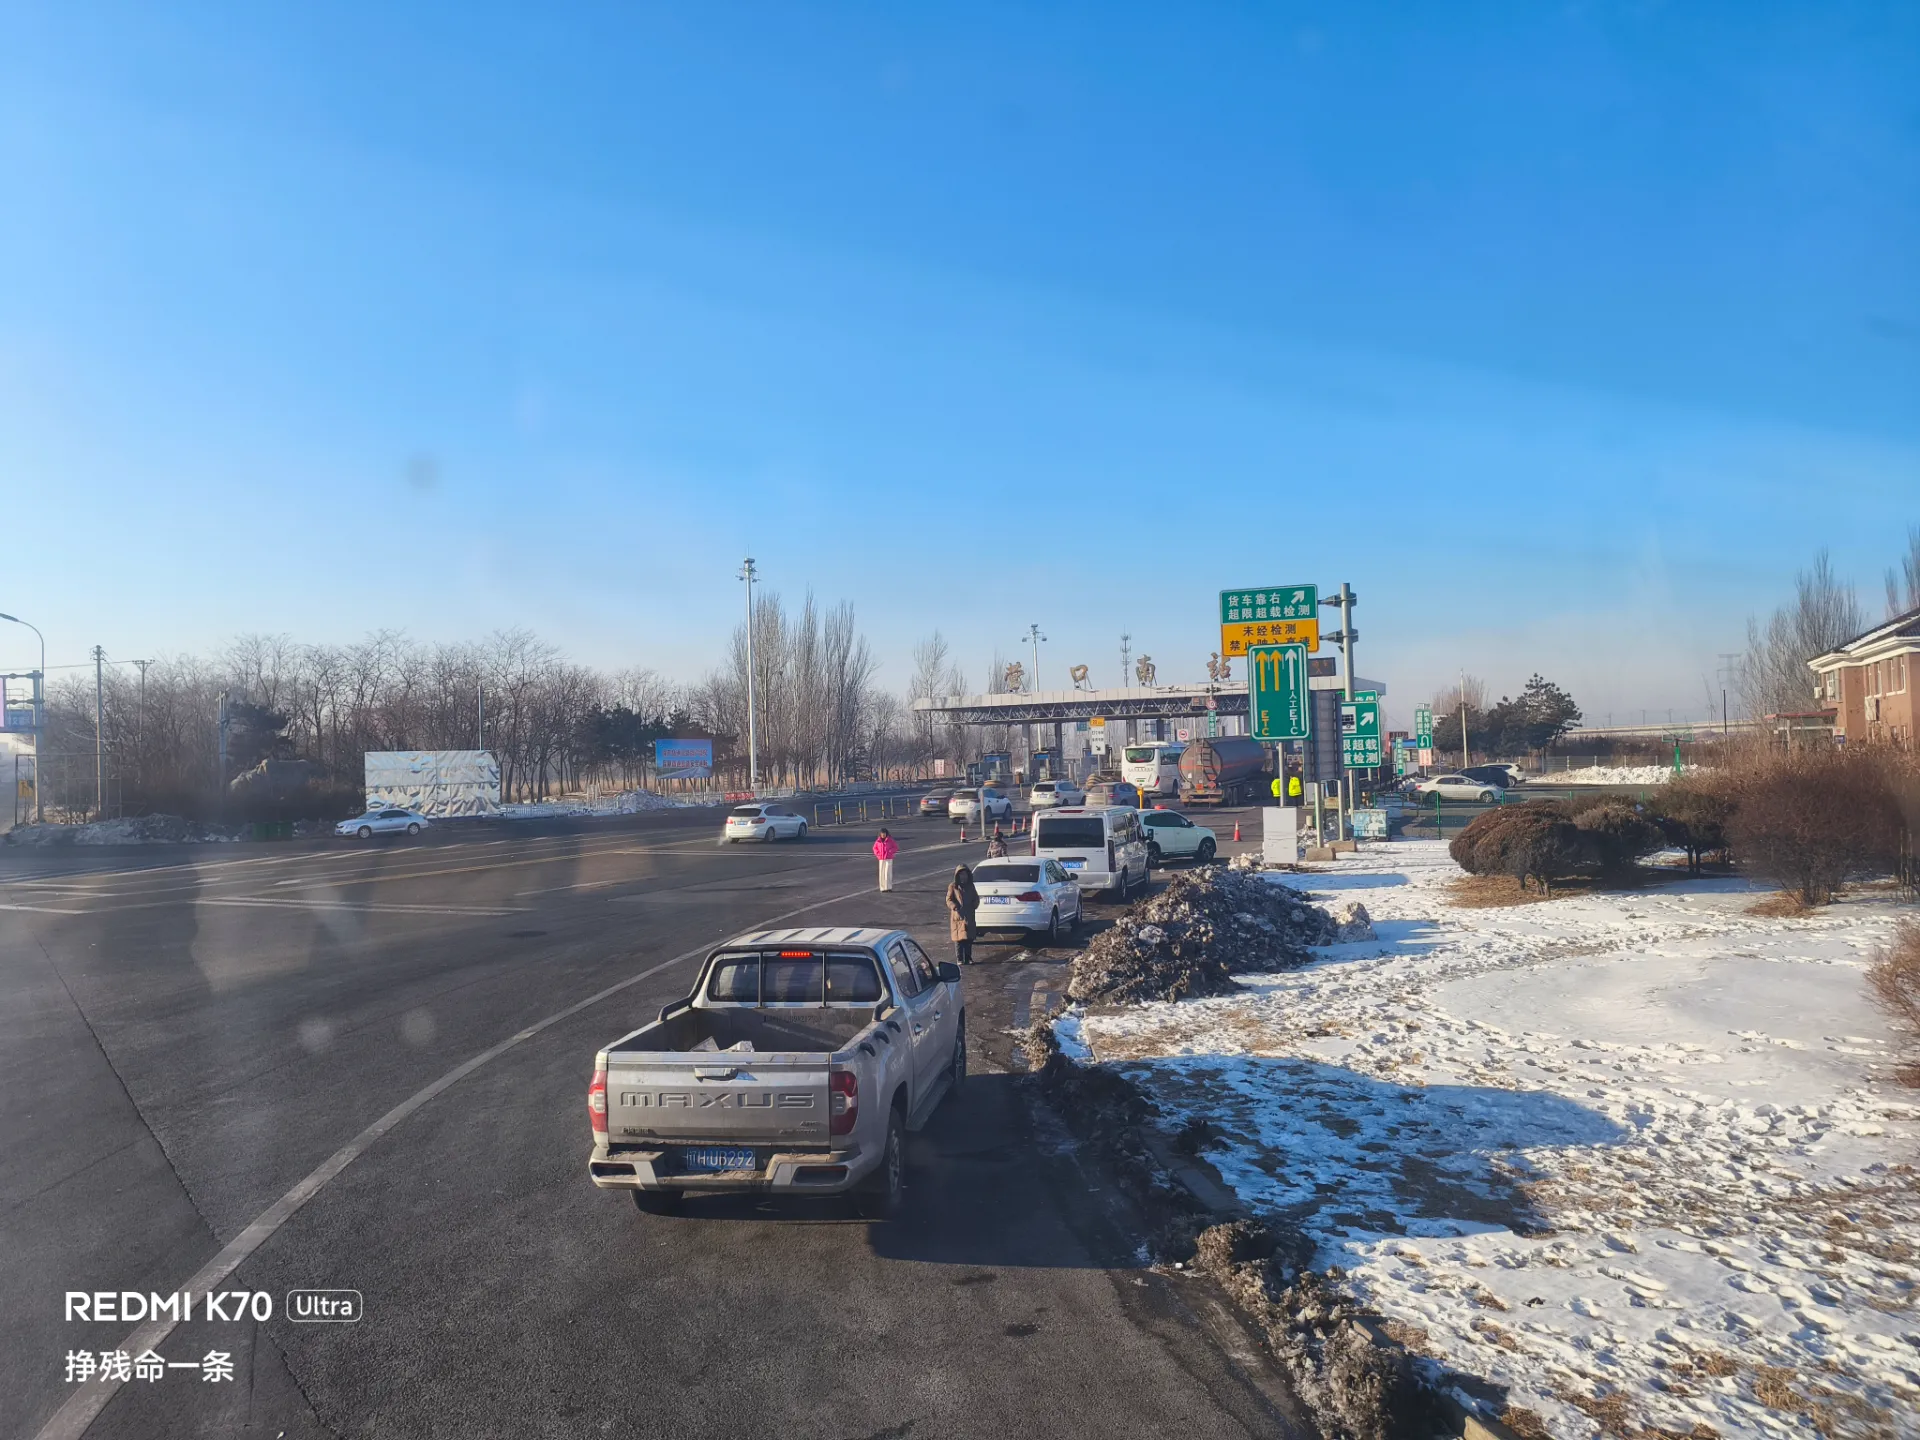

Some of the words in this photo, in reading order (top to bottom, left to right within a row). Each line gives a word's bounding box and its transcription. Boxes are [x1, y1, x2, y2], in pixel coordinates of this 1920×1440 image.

[1228, 592, 1280, 607] 货车靠右
[1228, 604, 1310, 620] 超限超载检测
[1243, 624, 1296, 636] 未经检测
[1261, 710, 1269, 736] ETC
[620, 1091, 815, 1109] MAXUS
